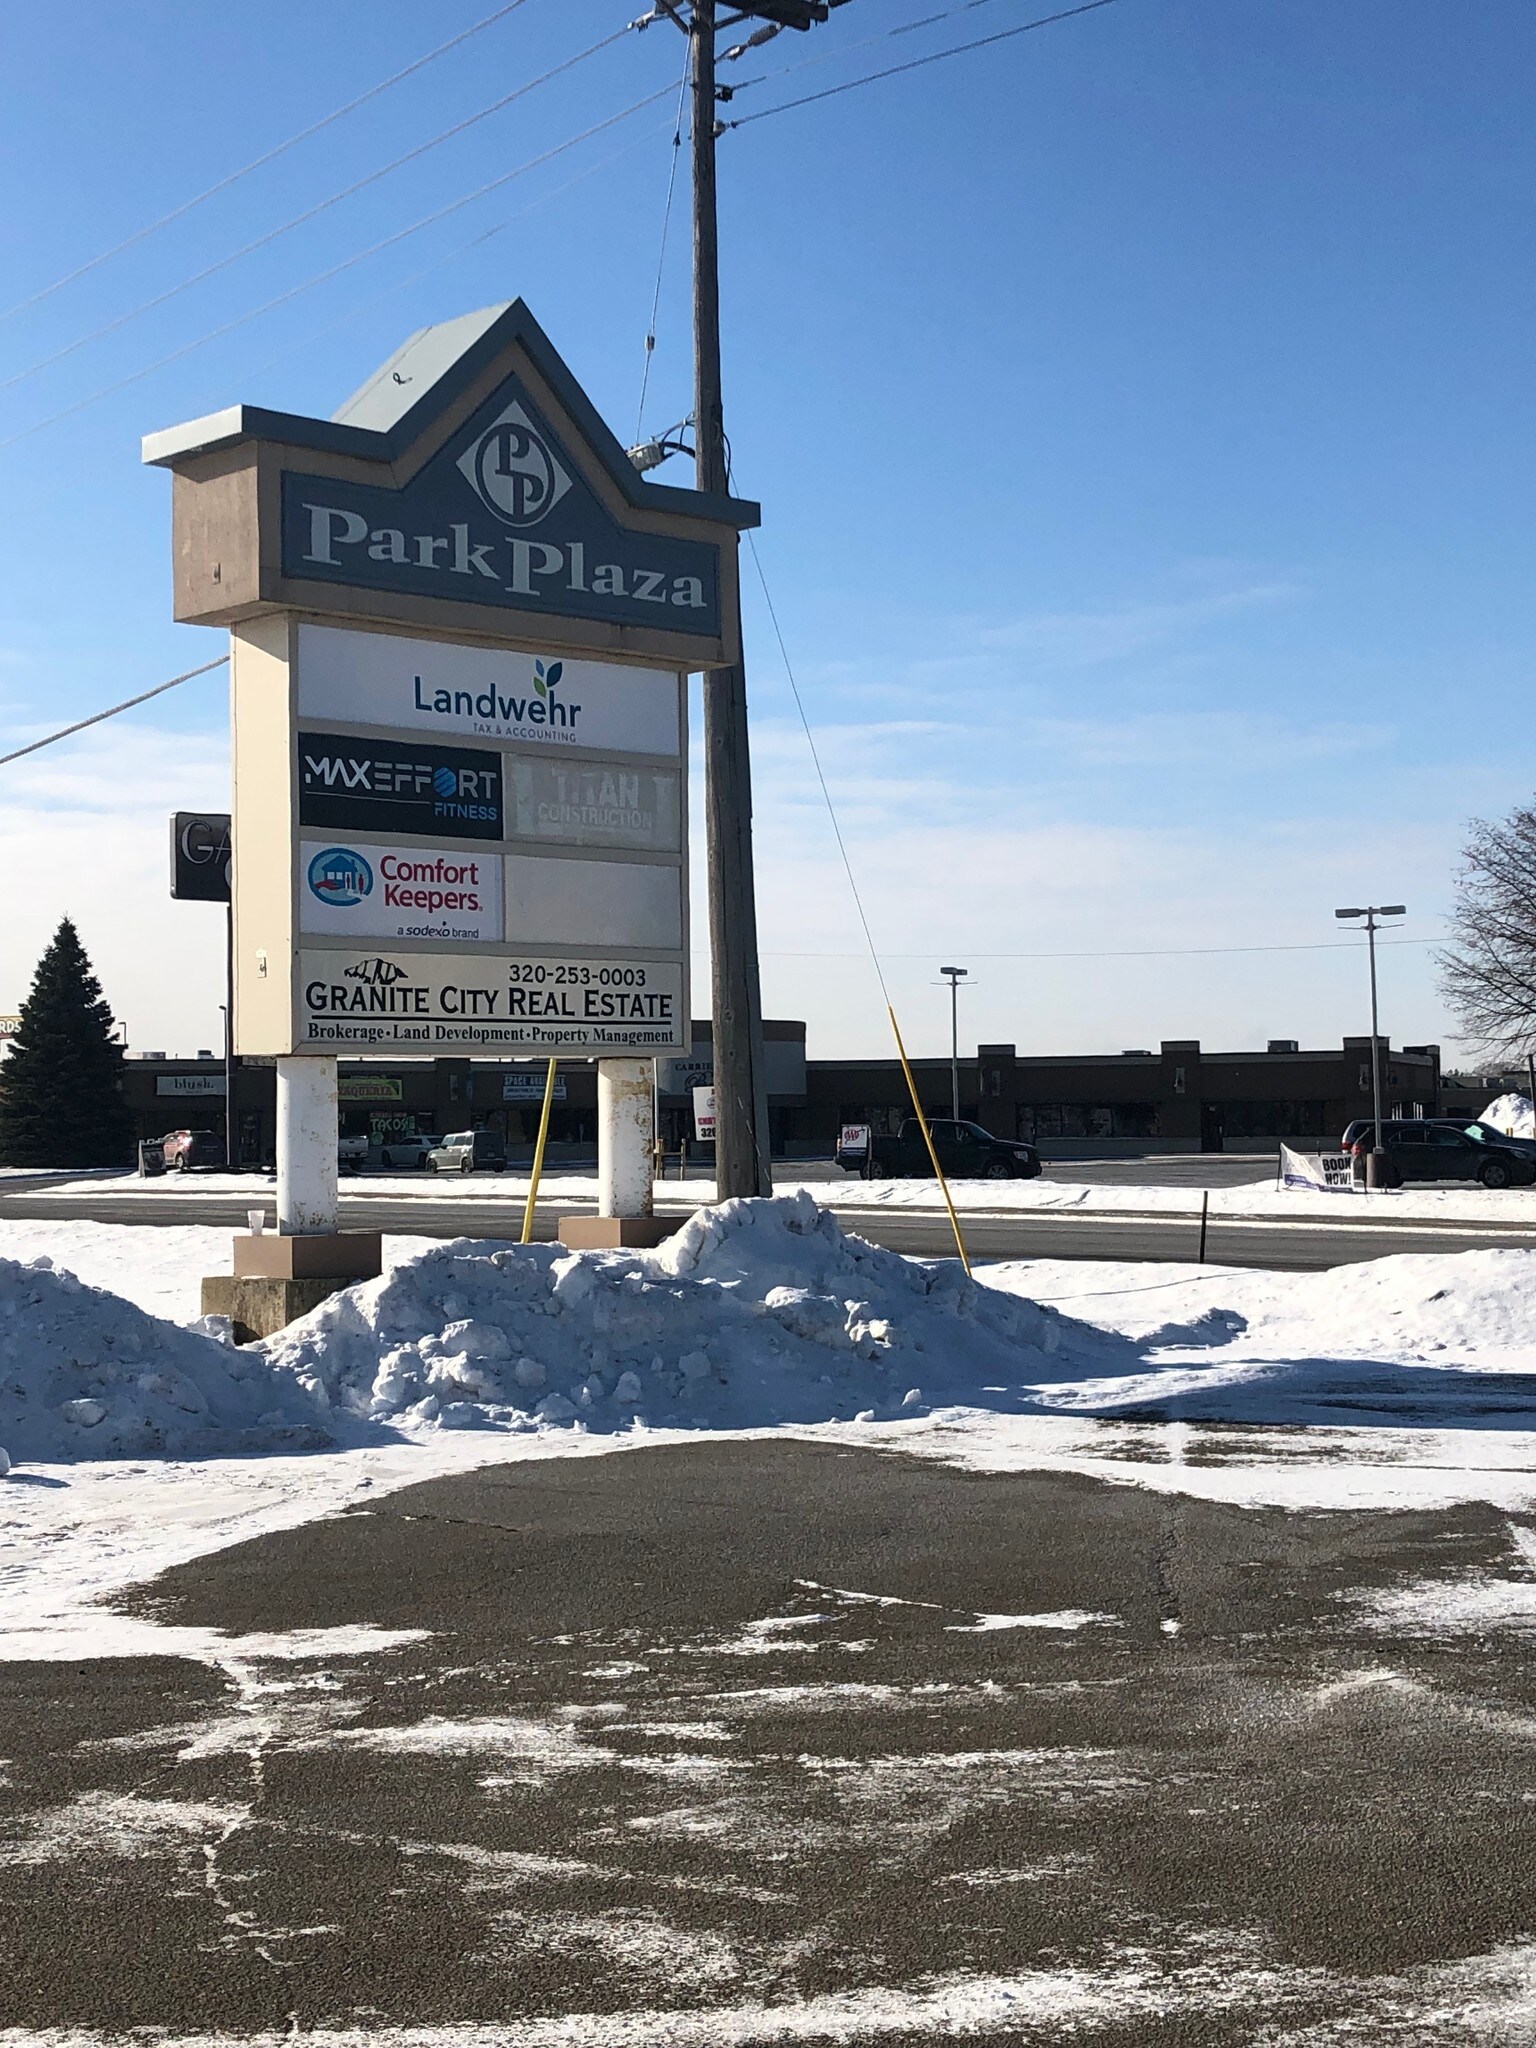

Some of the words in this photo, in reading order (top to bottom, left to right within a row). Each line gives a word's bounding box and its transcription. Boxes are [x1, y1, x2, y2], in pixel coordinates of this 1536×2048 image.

[301, 503, 500, 581] Park
[504, 535, 707, 608] Plaza
[414, 675, 582, 728] Landwehr
[473, 722, 492, 734] TAX
[496, 725, 502, 735] &
[505, 727, 577, 743] ACCOUNTING
[434, 802, 498, 821] FITNESS
[537, 802, 652, 829] CONSTRUCTION
[380, 854, 479, 885] Comfort
[397, 926, 404, 936] a
[405, 921, 451, 937] sodexo
[452, 927, 480, 939] brand
[509, 964, 646, 987] 320-253-0003
[305, 981, 430, 1014] GRANITE
[440, 985, 500, 1016] CITY
[508, 987, 575, 1017] REAL
[584, 989, 673, 1018] ESTATE
[307, 1022, 384, 1043] Brokerage
[393, 1024, 431, 1040] Land
[435, 1025, 524, 1044] Development
[532, 1027, 590, 1045] Property
[593, 1028, 674, 1046] Management
[504, 1076, 527, 1086] SPACE
[370, 1118, 406, 1131] TACOS
